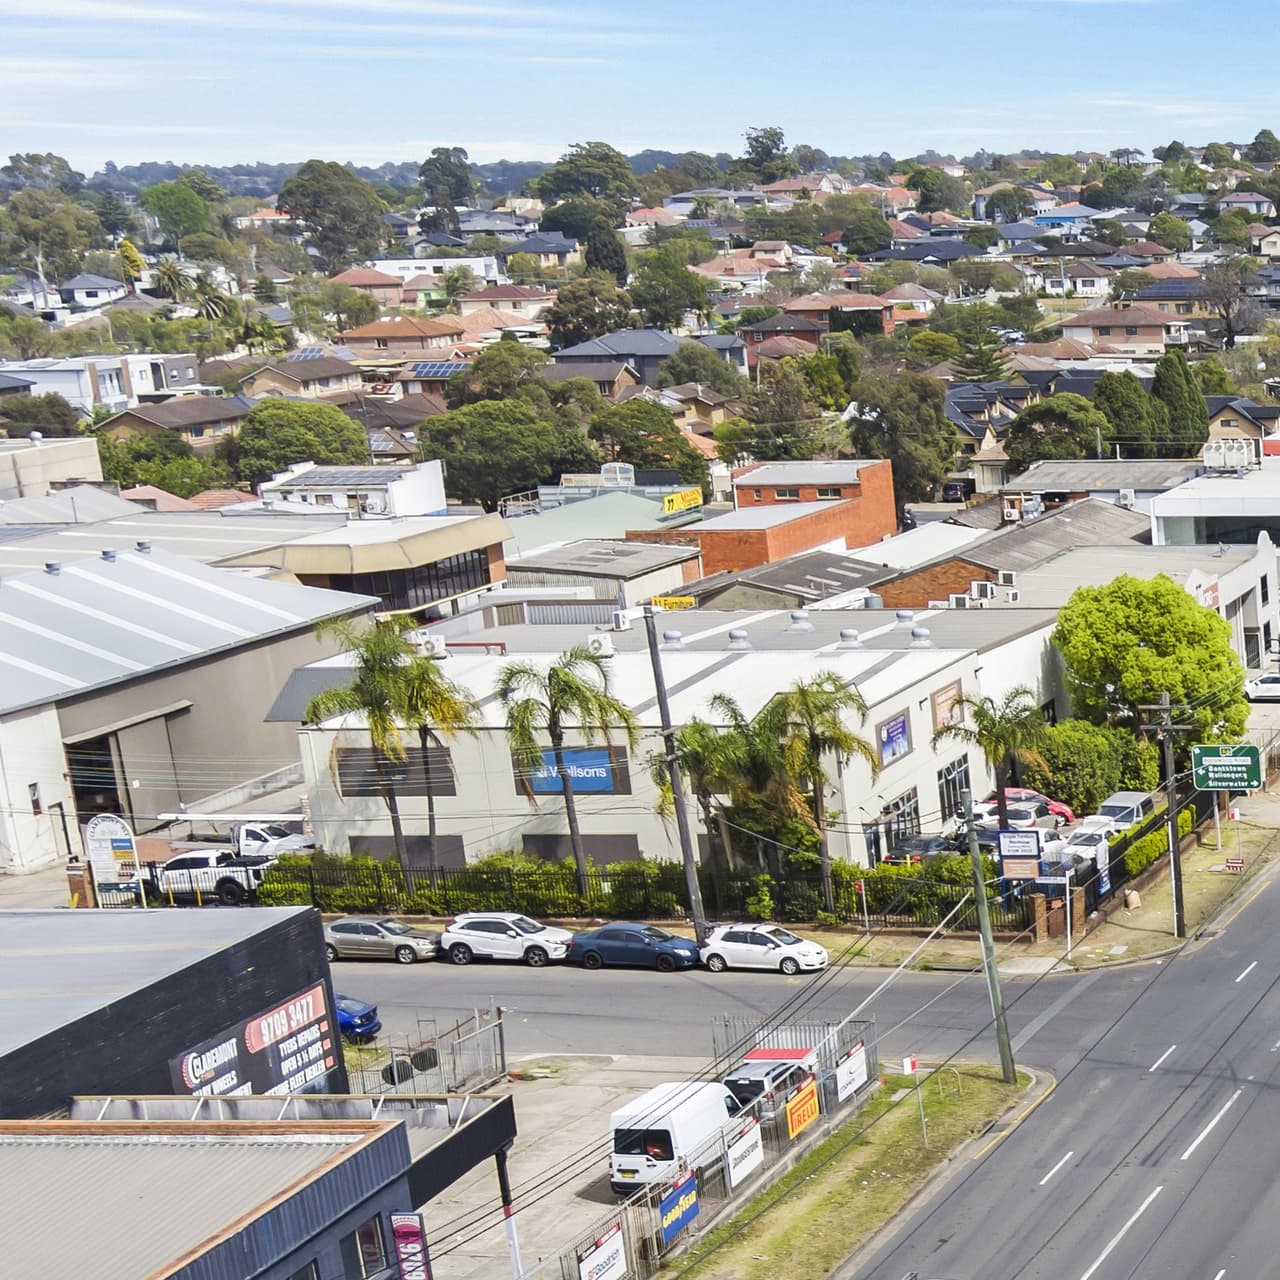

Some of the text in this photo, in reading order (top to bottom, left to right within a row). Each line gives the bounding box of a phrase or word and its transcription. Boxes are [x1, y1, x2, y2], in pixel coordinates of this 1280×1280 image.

[549, 765, 607, 778] Wllsons
[260, 996, 313, 1042] 9709 3477
[188, 1037, 238, 1083] CLAREMONT
[789, 1088, 818, 1133] PIRELLI
[662, 1190, 697, 1228] GOODYEAR
